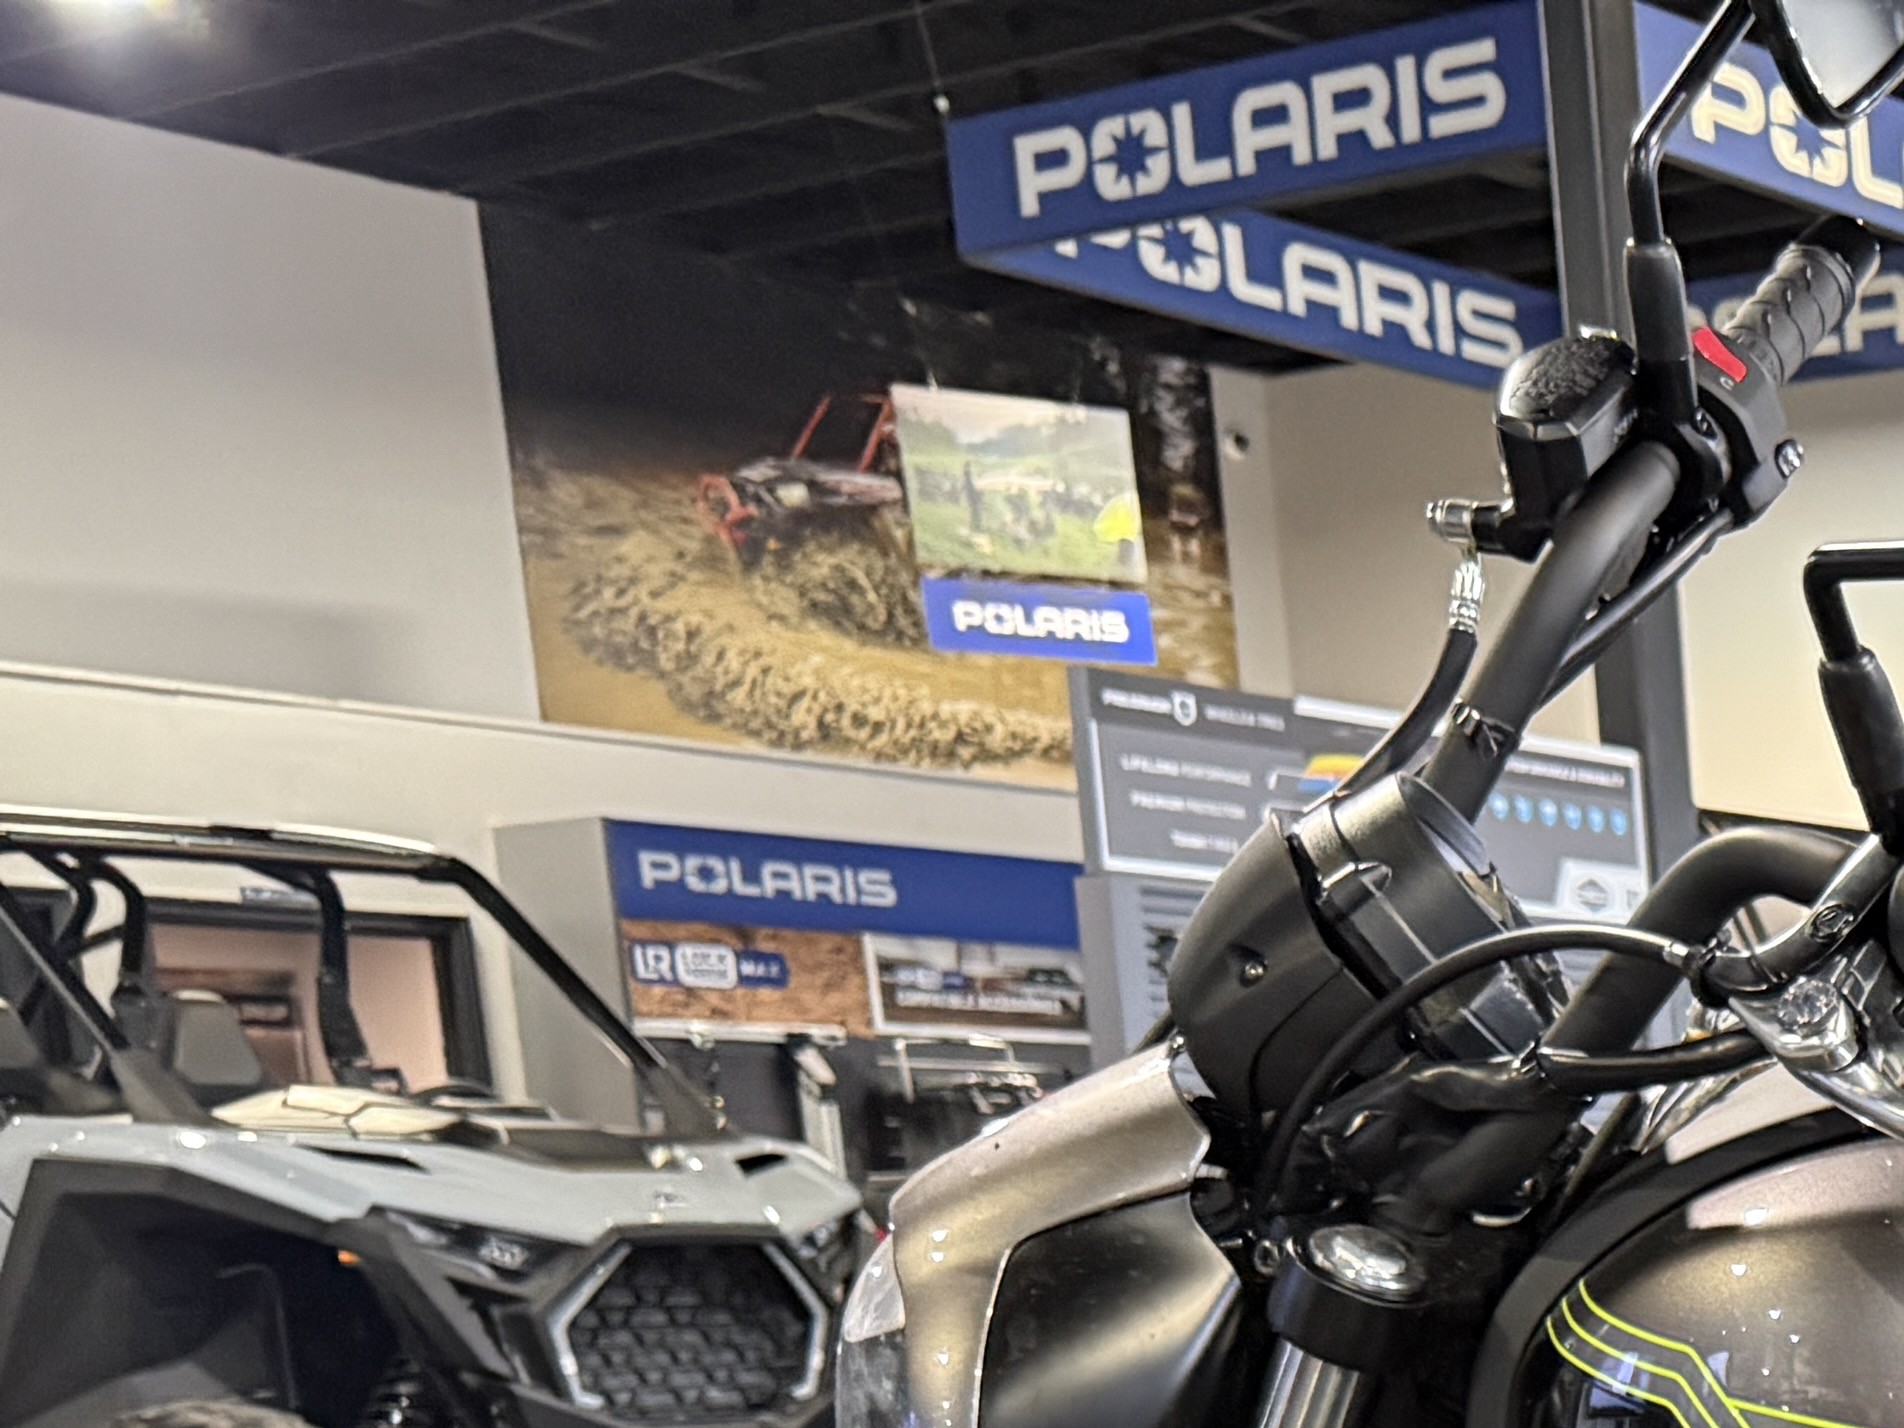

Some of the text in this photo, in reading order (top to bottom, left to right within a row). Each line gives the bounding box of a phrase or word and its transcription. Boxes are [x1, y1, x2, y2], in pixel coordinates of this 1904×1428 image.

[1013, 37, 1507, 218] POLARIS
[1055, 216, 1525, 369] OLARIS
[952, 600, 1129, 643] POLARIS
[637, 850, 898, 908] POLARIS
